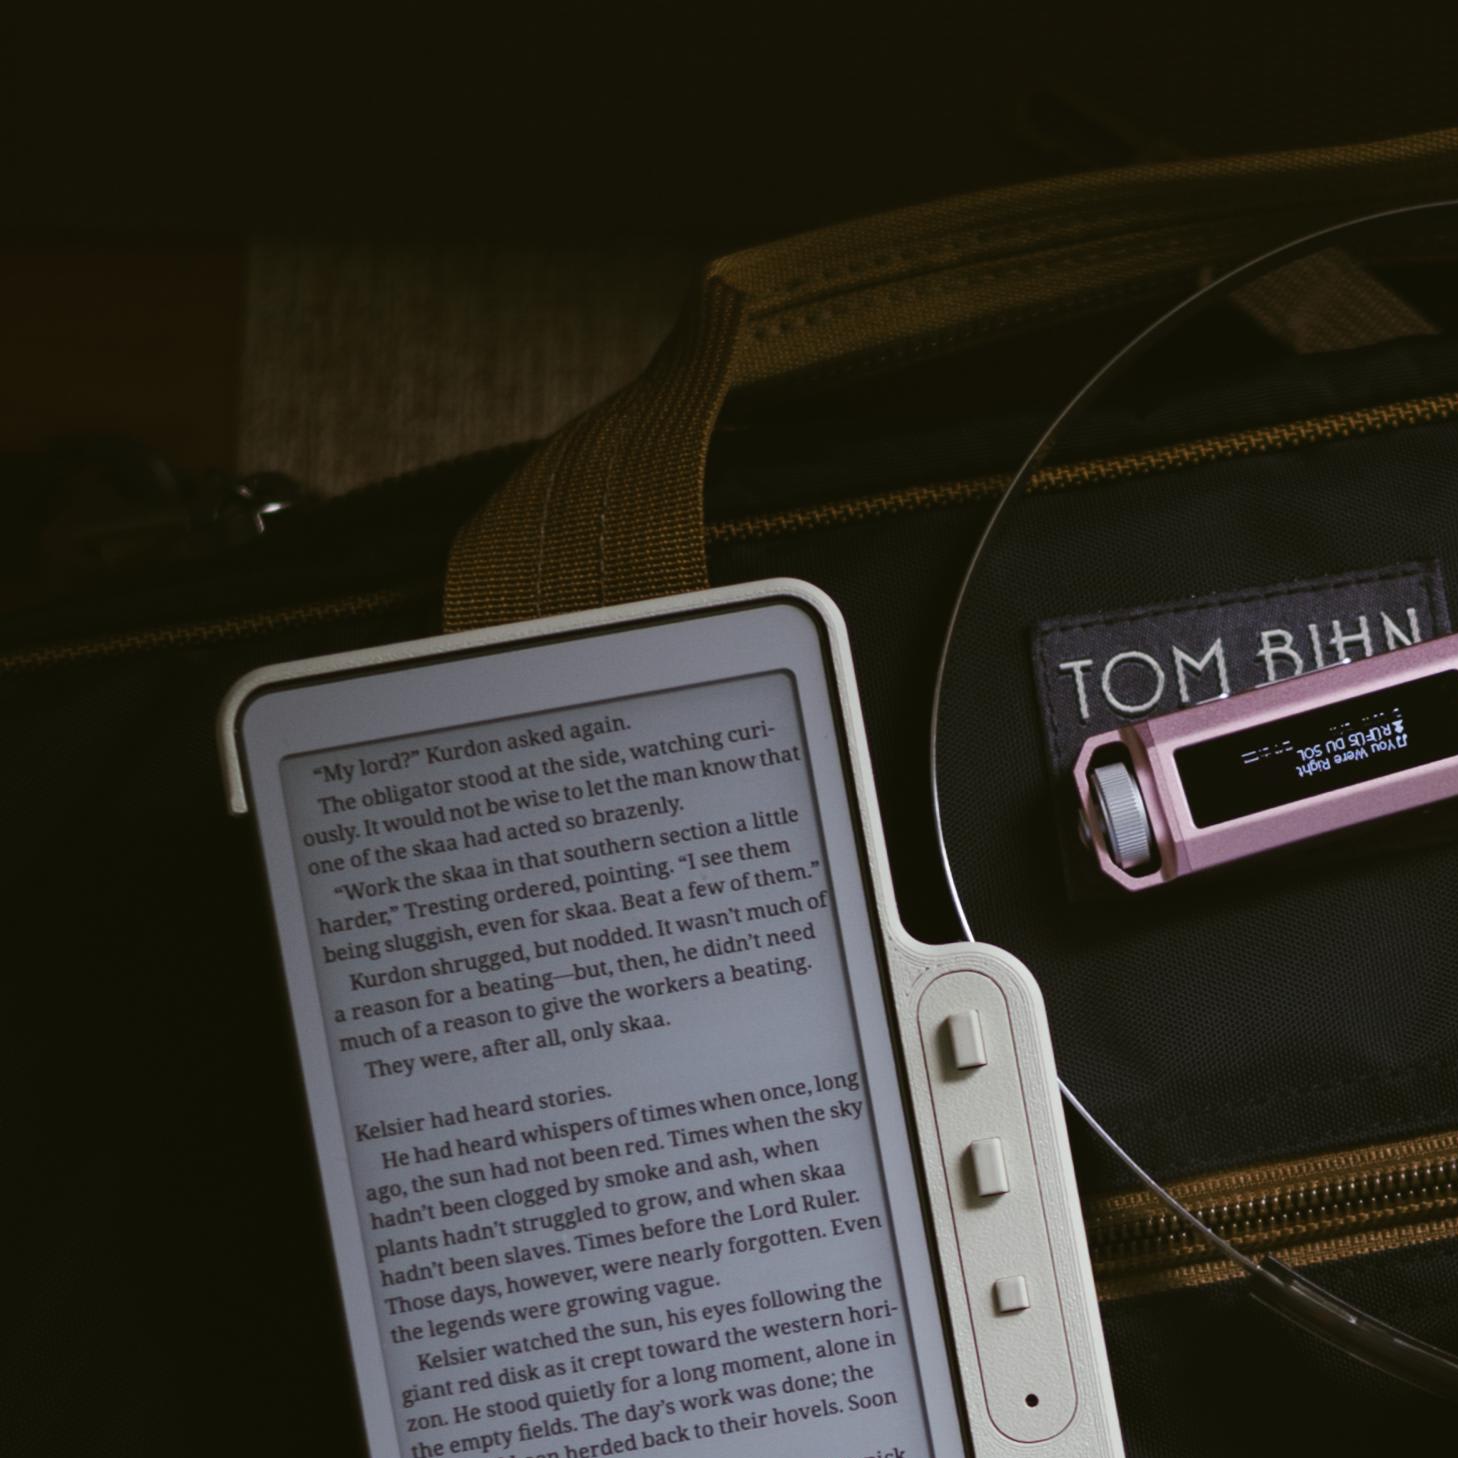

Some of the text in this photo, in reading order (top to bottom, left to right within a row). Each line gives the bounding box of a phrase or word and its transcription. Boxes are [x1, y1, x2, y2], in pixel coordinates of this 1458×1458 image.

[1060, 608, 1421, 720] TOM BIHN
[311, 714, 631, 785] “My lord?” Kurdon asked again.
[1295, 739, 1397, 777] You Were Right
[1296, 744, 1323, 760] SOL
[1325, 737, 1346, 754] DU
[301, 744, 801, 847] ously. It would not be wise to let the man know that
[332, 805, 799, 901] “Work the skaa in that southern section a little
[320, 858, 820, 964] being sluggish, even for skaa. Beat a few of them.”
[333, 920, 817, 1023] a reason for a beating—but, then, he didn’t need
[362, 1013, 671, 1079] They were, after all, only skaa.
[353, 1084, 612, 1143] Kelsier had heard stories.
[373, 1162, 846, 1264] plants hadn’t struggled to grow, and when skaa
[382, 1214, 883, 1316] Those days, however, were nearly forgotten. Even
[415, 1273, 882, 1372] Kelsier watched the sun, his eyes following the
[405, 1329, 897, 1433] zon. He stood quietly for a long moment, alone in
[639, 1424, 691, 1449] back
[692, 1422, 715, 1439] to
[717, 1410, 768, 1435] their
[771, 1397, 844, 1425] hovels.
[846, 1390, 898, 1412] Soon
